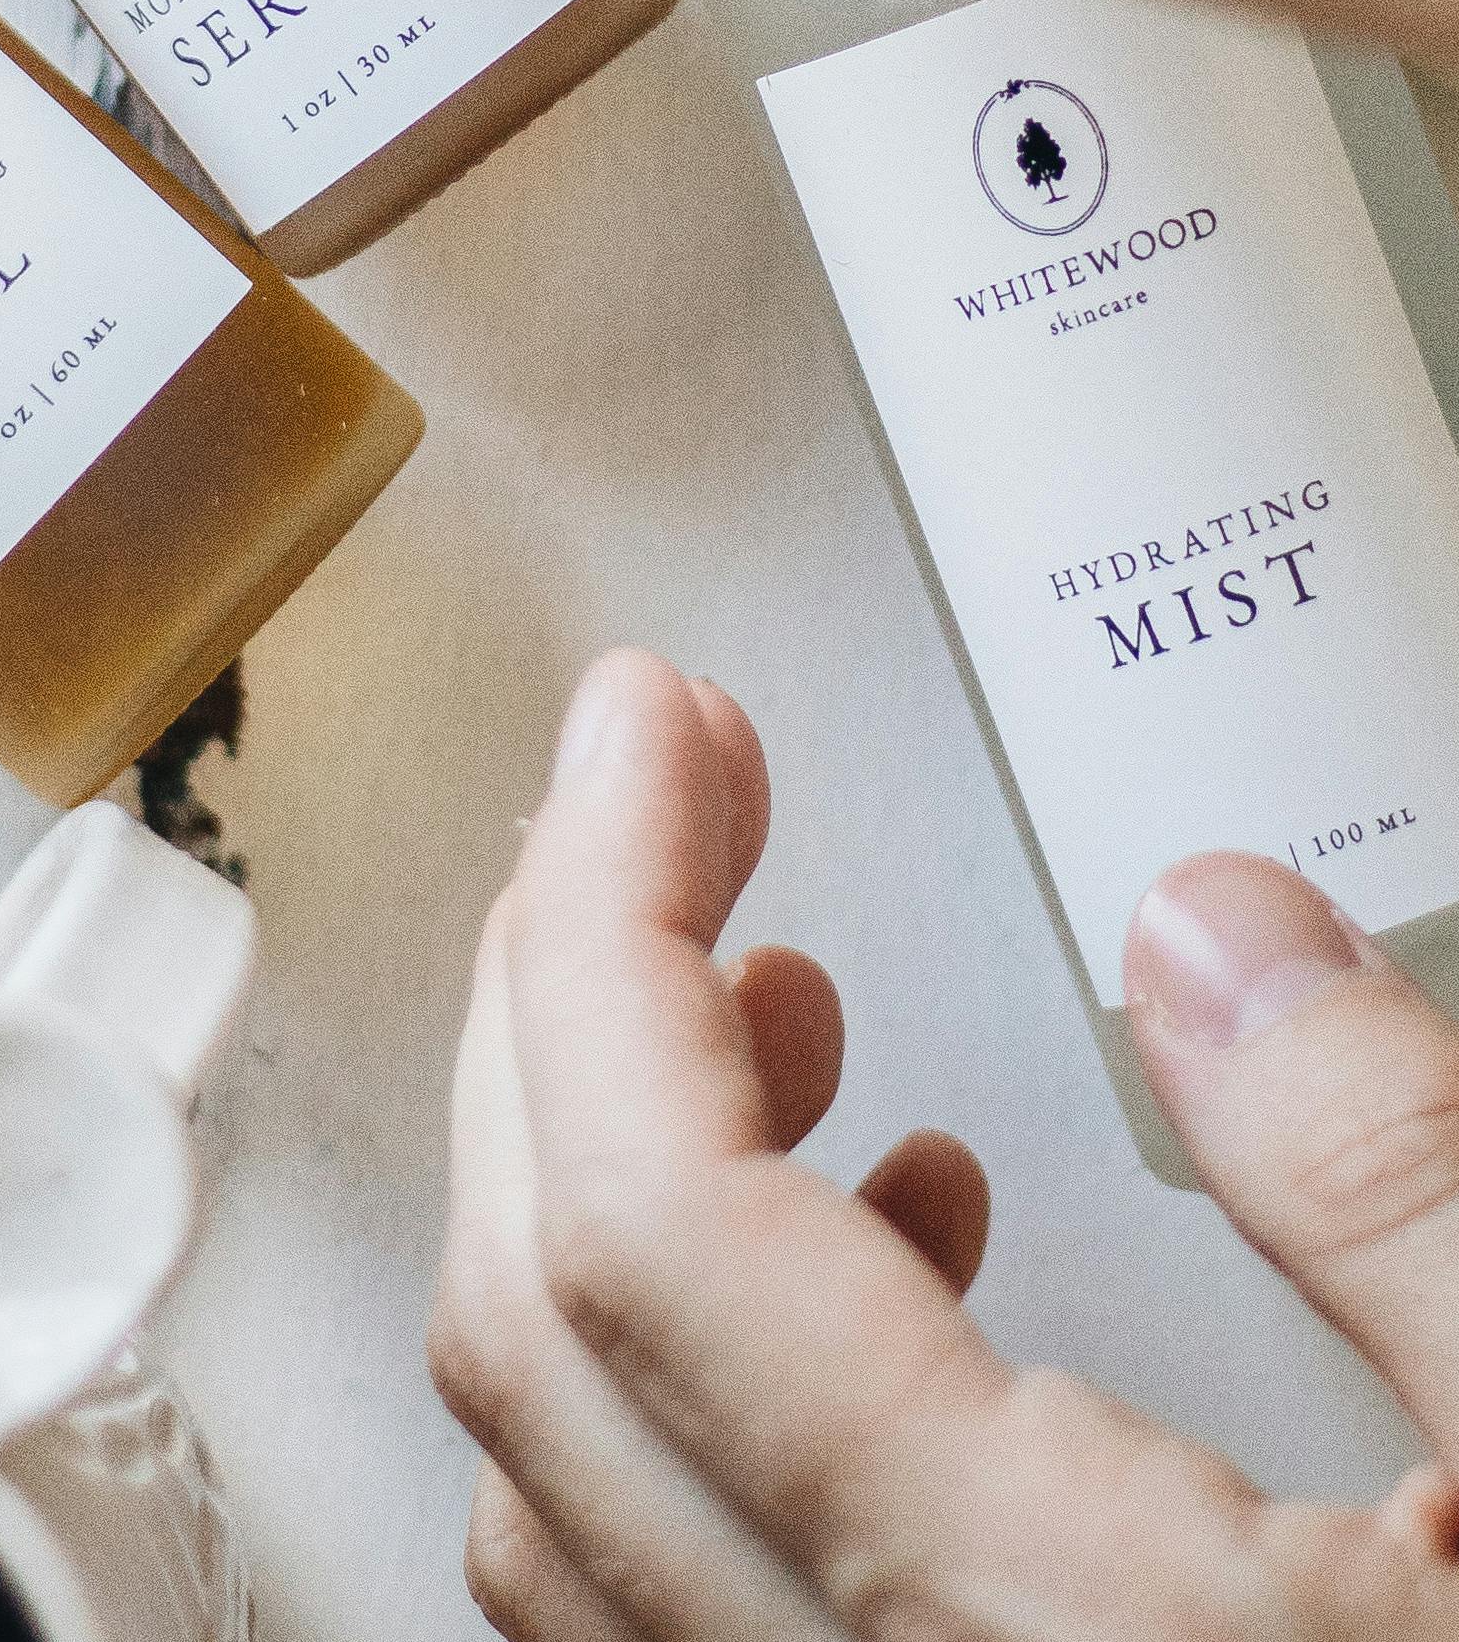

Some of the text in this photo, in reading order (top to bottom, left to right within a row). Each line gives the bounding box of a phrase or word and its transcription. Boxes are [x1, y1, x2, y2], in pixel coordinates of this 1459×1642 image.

[281, 114, 298, 133] 1
[356, 43, 391, 78] 30
[396, 15, 436, 48] ML
[953, 206, 1219, 321] WHITEWOOD
[1049, 289, 1149, 337] skincare
[50, 349, 81, 385] 60
[82, 317, 118, 350] ML
[1048, 478, 1332, 603] HYDRATING
[1094, 539, 1318, 671] MIST
[1312, 821, 1365, 858] 100
[1376, 807, 1417, 835] ML
